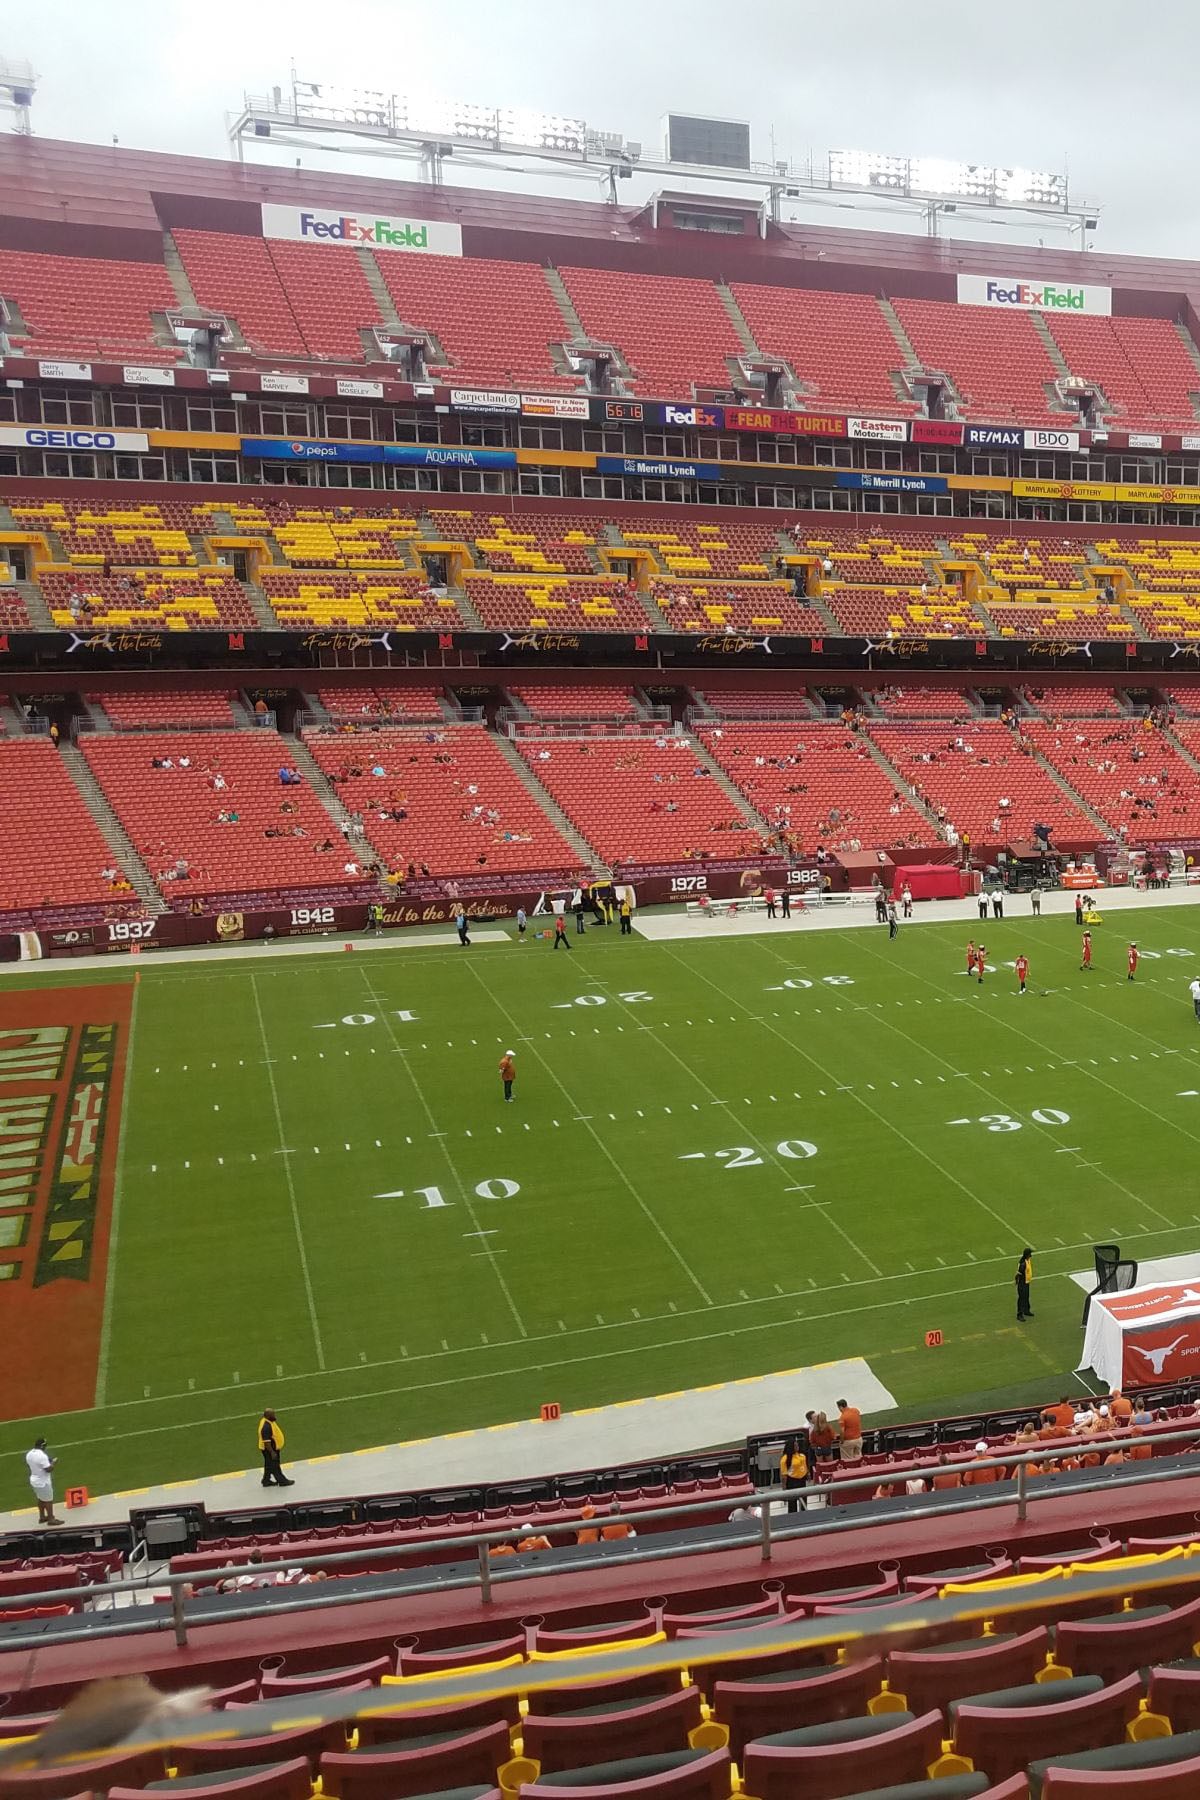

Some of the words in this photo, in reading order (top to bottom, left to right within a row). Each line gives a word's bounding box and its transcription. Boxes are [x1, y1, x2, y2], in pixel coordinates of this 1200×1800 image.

[300, 212, 428, 248] FedExField
[986, 281, 1084, 309] FedExField
[41, 369, 64, 377] SMITH
[125, 368, 141, 377] Gary
[126, 374, 150, 382] CLARK
[262, 376, 276, 384] Ken
[263, 383, 289, 391] HARVEY
[453, 391, 508, 405] Carpetland
[524, 405, 554, 414] Support
[555, 405, 586, 413] LEARN
[608, 404, 641, 417] 56:16
[665, 406, 717, 426] FedEx
[861, 420, 903, 432] Eastern
[26, 430, 116, 449] GEICO
[970, 430, 1020, 445] RE/MAX
[1038, 432, 1069, 446] BDO
[306, 446, 338, 457] pepsi
[425, 449, 475, 464] AQUAFINA
[637, 462, 667, 474] Merrill
[668, 464, 696, 477] Lynch
[873, 476, 900, 487] Merrill
[901, 478, 926, 490] Lynch
[1025, 485, 1060, 494] MARYLAND
[1074, 489, 1102, 497] LOTTERY
[1128, 491, 1162, 499] MARYLAND
[671, 876, 707, 892] 1972
[786, 870, 820, 885] 1982
[291, 907, 334, 925] 1942
[381, 906, 406, 923] ail
[405, 907, 420, 921] to
[422, 904, 446, 920] the
[109, 921, 156, 941] 1937
[977, 1107, 1071, 1132] 30
[714, 1139, 819, 1169] 20
[412, 1178, 521, 1209] 10
[928, 1331, 943, 1346] 20
[542, 1403, 559, 1420] 10
[69, 1489, 84, 1507] G
